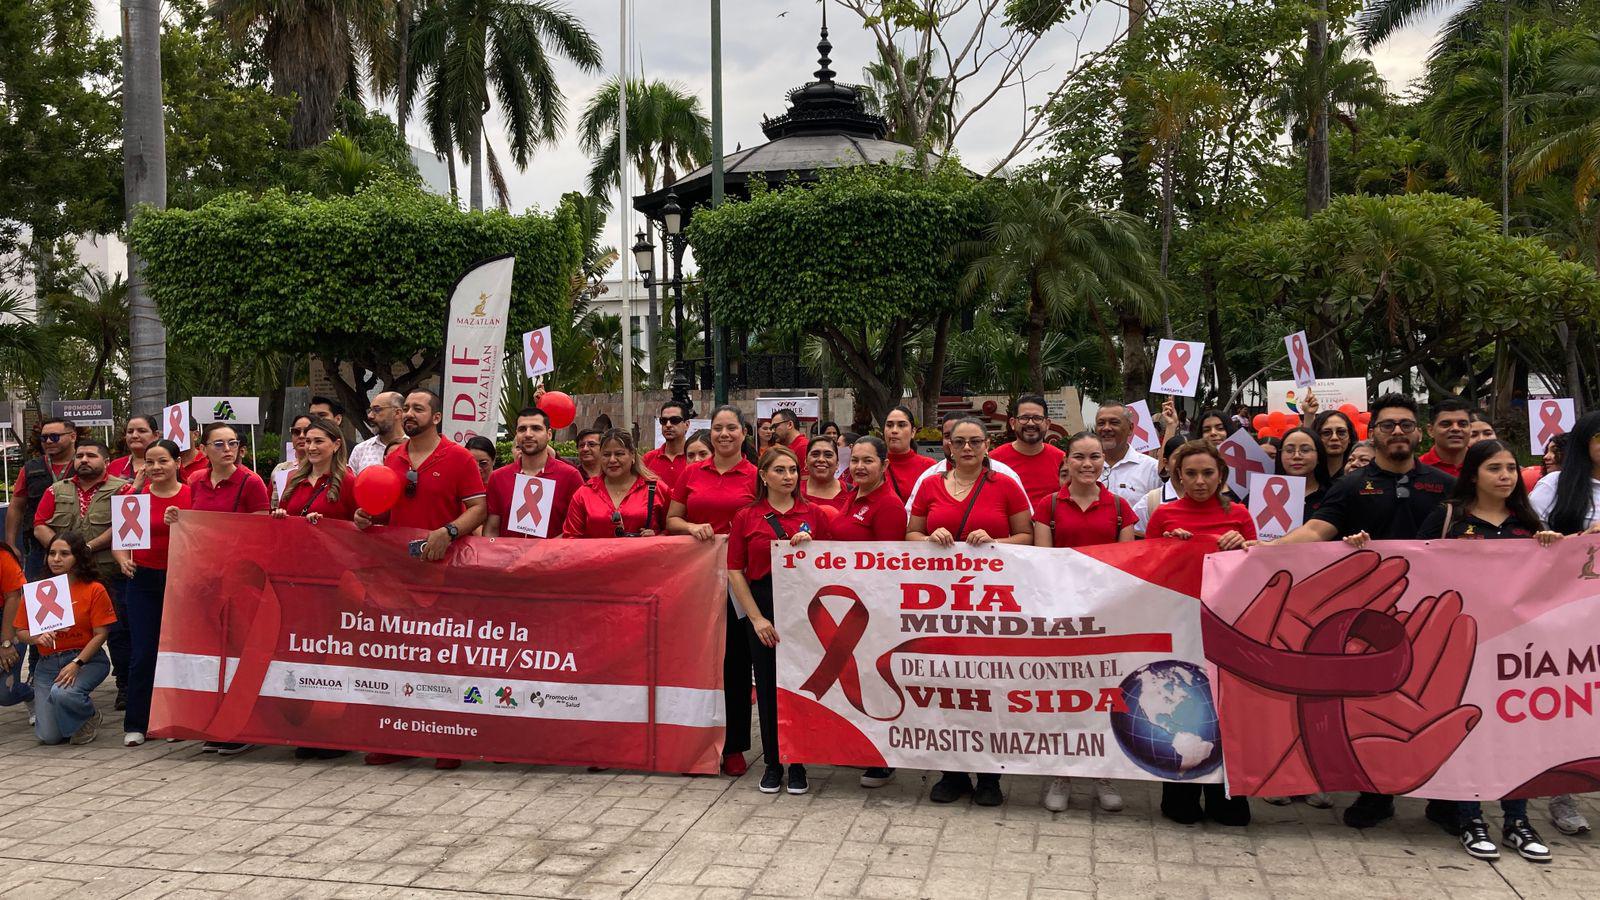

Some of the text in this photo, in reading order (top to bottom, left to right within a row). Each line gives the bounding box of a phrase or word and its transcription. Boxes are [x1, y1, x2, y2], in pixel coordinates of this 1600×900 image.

[451, 345, 480, 422] DIF
[814, 552, 847, 570] de
[854, 551, 1004, 572] Diciembre
[900, 576, 1021, 612] DÍA
[340, 610, 529, 642] Día Mundial de la
[900, 613, 1106, 637] MUNDIAL
[289, 633, 577, 673] Lucha contra el VIH/SIDA
[1496, 642, 1600, 681] DÍA M
[298, 677, 343, 688] SINALOA
[901, 658, 1124, 681] DE LA LUCHA CONTRA EL
[354, 679, 389, 691] SALUD
[415, 684, 452, 694] CENSIDA
[545, 693, 578, 701] Promoción
[904, 685, 1130, 713] VIH SIDA
[1496, 681, 1600, 724] CON
[393, 719, 409, 731] de
[411, 720, 478, 737] Diciembre
[888, 725, 1105, 757] CAPASITS MAZATLAN
